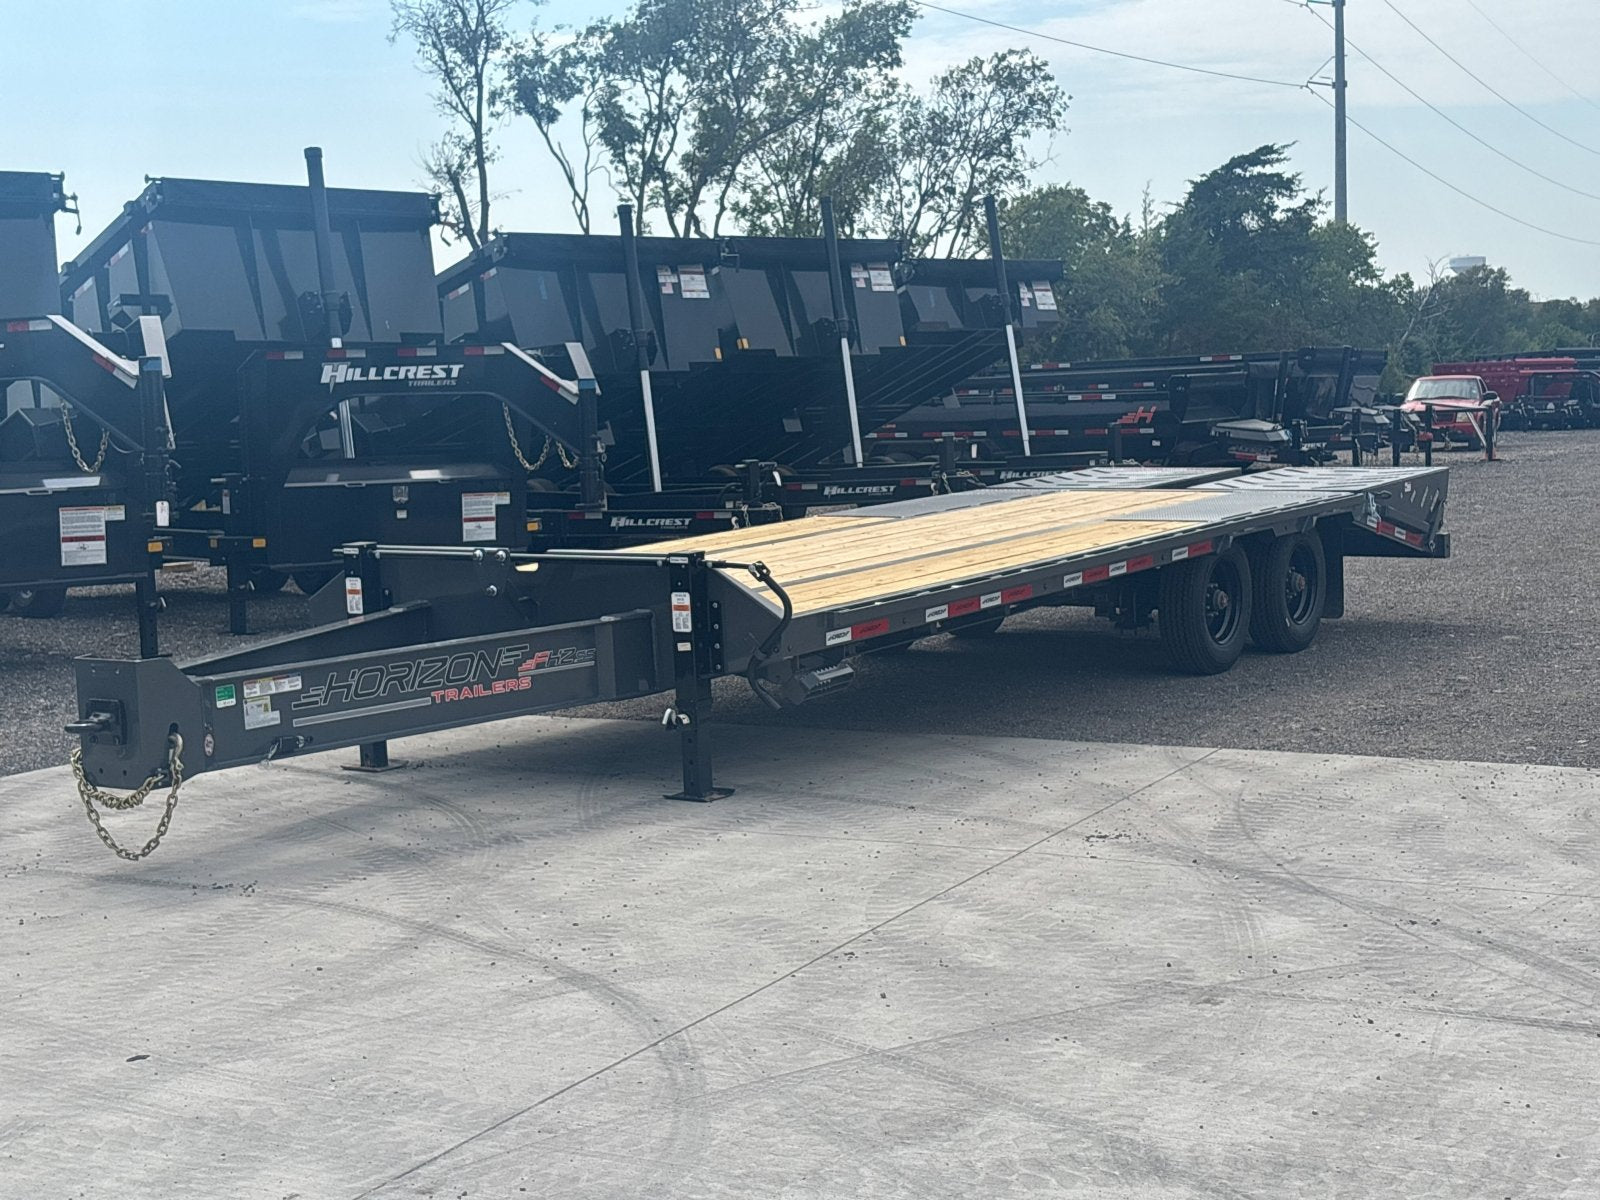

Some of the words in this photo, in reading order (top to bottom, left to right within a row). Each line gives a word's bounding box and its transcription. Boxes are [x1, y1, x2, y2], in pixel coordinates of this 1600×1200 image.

[320, 363, 464, 385] HILLCREST
[823, 485, 896, 496] HILLCREST
[610, 516, 692, 528] HILLCREST
[320, 648, 505, 706] HORIZON
[431, 676, 532, 704] TRAILERS
